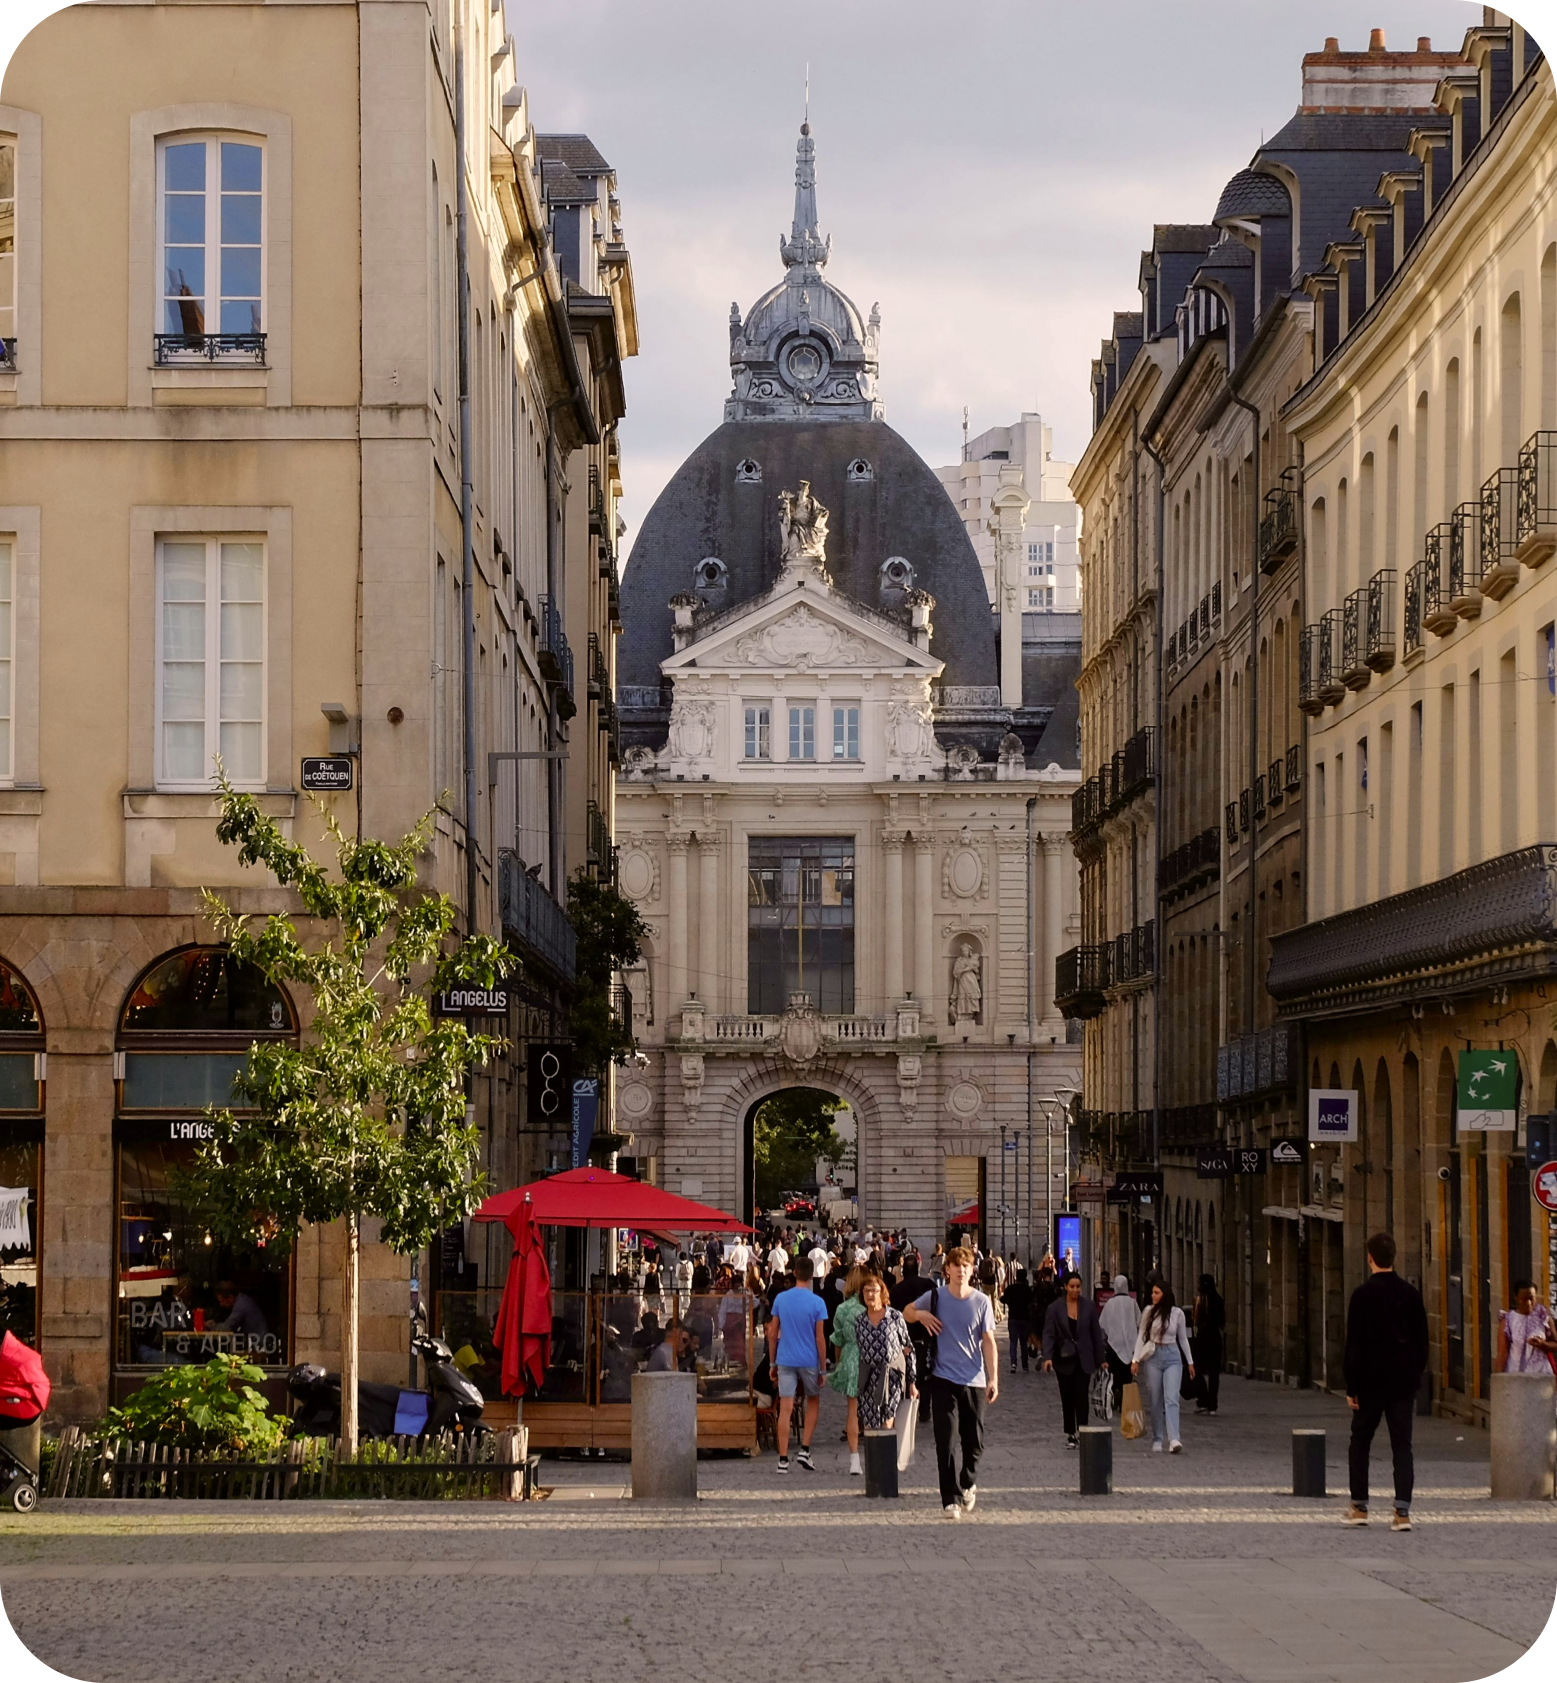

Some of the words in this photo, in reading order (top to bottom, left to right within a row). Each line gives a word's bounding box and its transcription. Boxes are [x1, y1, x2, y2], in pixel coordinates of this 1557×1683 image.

[1319, 1113, 1348, 1124] ARCH
[571, 1147, 579, 1169] ÉDIT
[1241, 1152, 1258, 1162] RO
[1241, 1163, 1258, 1172] XY
[1119, 1183, 1160, 1191] ZARA
[131, 1301, 187, 1328] BAR
